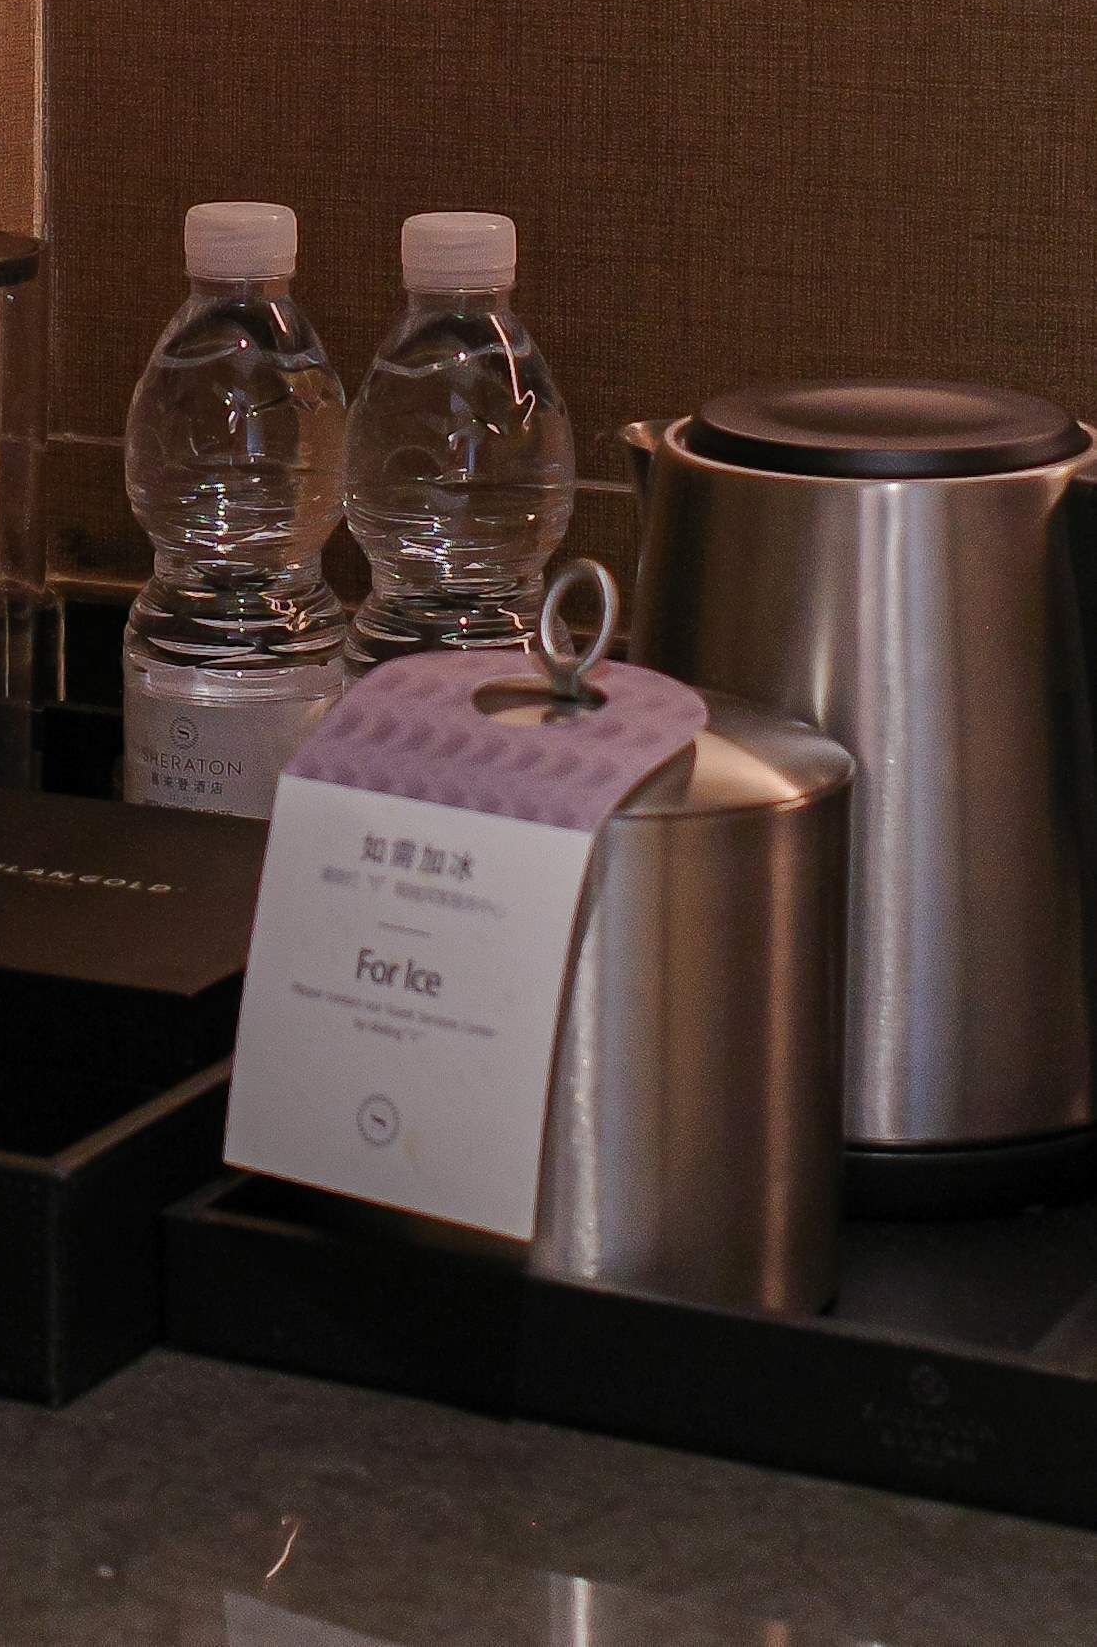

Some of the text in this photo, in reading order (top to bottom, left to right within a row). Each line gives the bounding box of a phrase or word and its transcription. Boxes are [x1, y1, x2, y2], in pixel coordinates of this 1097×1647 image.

[142, 753, 242, 776] SHERATON
[357, 946, 443, 998] For Ice
